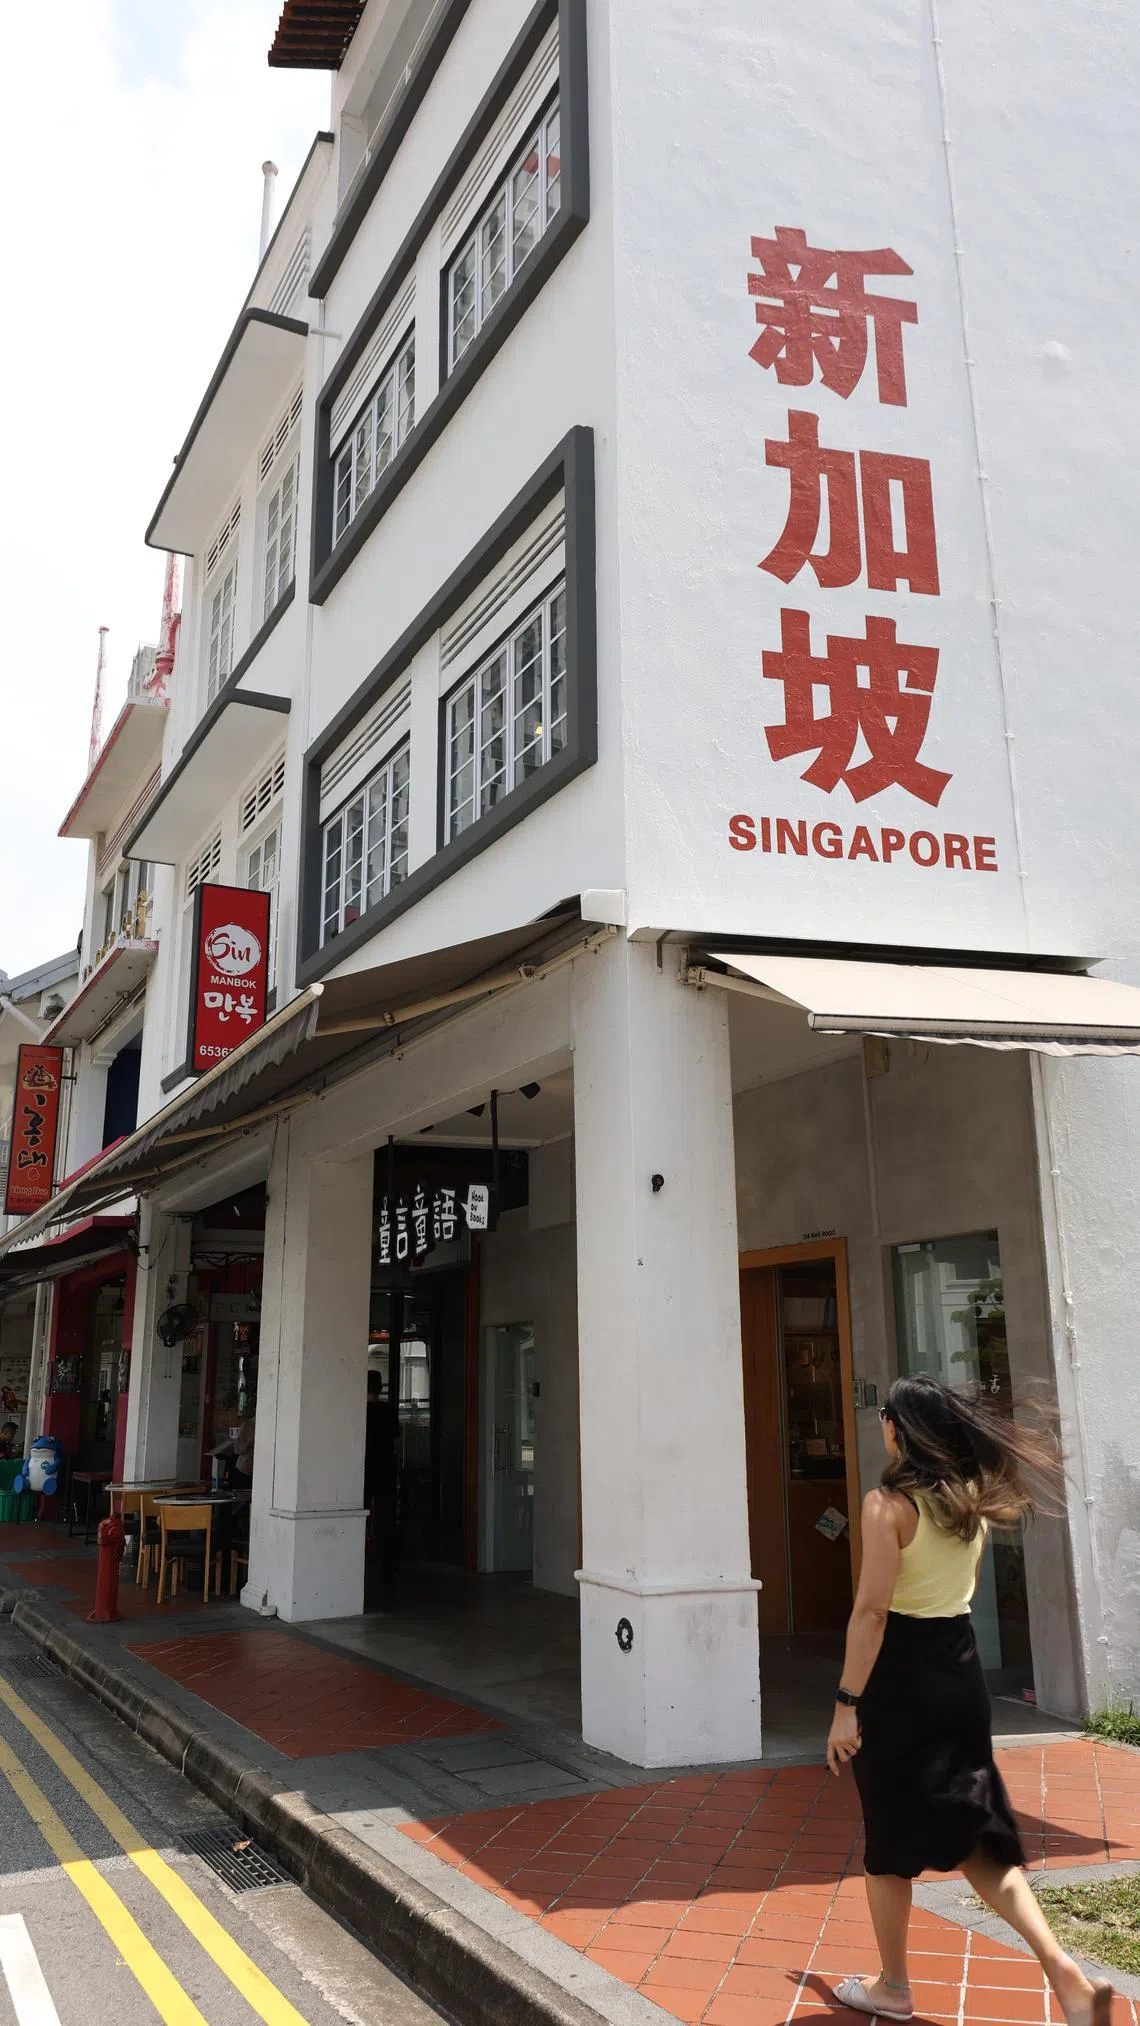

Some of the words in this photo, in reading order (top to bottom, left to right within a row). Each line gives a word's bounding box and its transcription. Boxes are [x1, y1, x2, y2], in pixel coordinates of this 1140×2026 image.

[748, 225, 953, 807] 新加坡
[728, 813, 999, 872] SINGAPORE
[211, 933, 250, 962] Sin
[211, 975, 256, 989] MANBOK
[203, 991, 258, 1025] 만복
